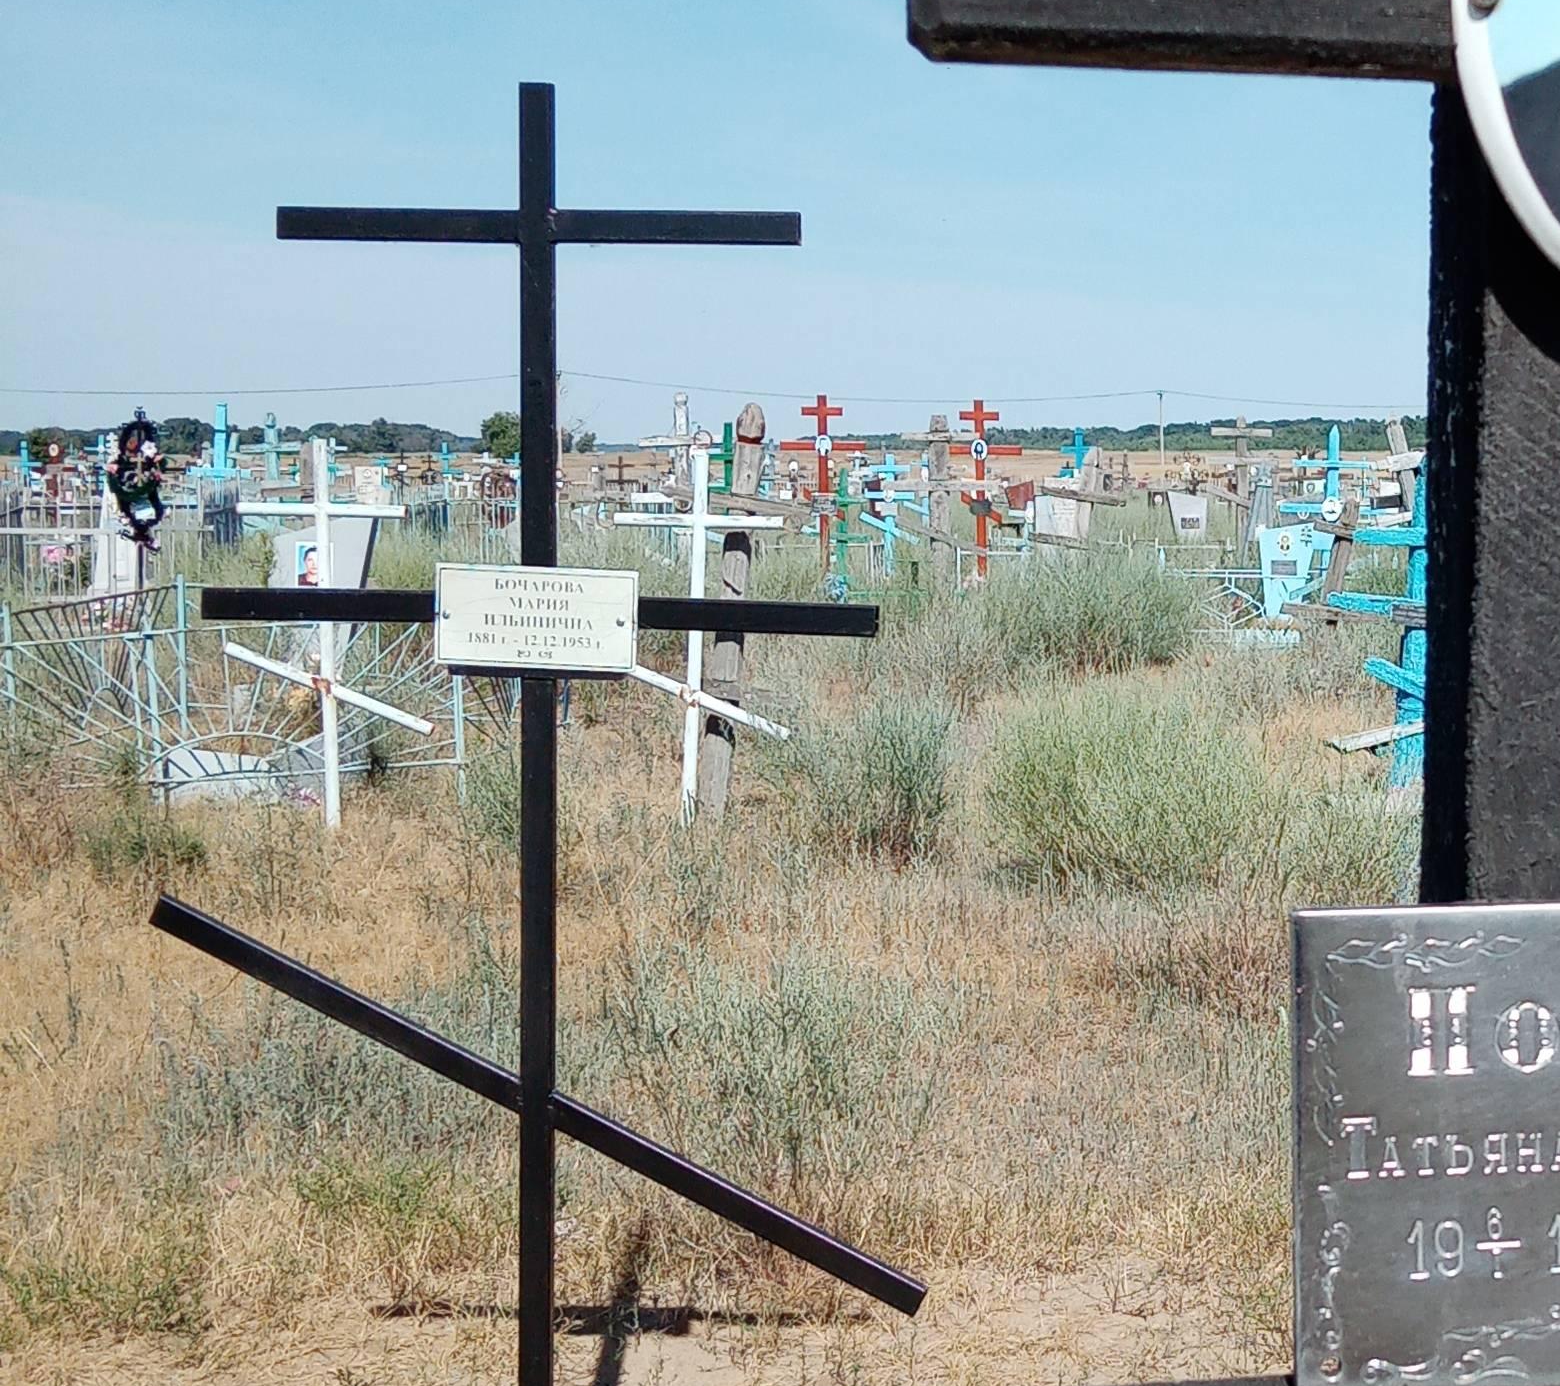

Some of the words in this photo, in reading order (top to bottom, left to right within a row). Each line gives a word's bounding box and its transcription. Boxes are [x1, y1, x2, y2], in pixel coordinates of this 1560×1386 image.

[494, 578, 584, 594] БОЧАРОВА
[509, 597, 569, 611] МАРИЯ
[483, 613, 593, 631] ИЛЬИНИЧНА
[467, 632, 496, 644] 1881
[524, 634, 591, 648] 12.12.1953
[1407, 1219, 1465, 1280] 19
